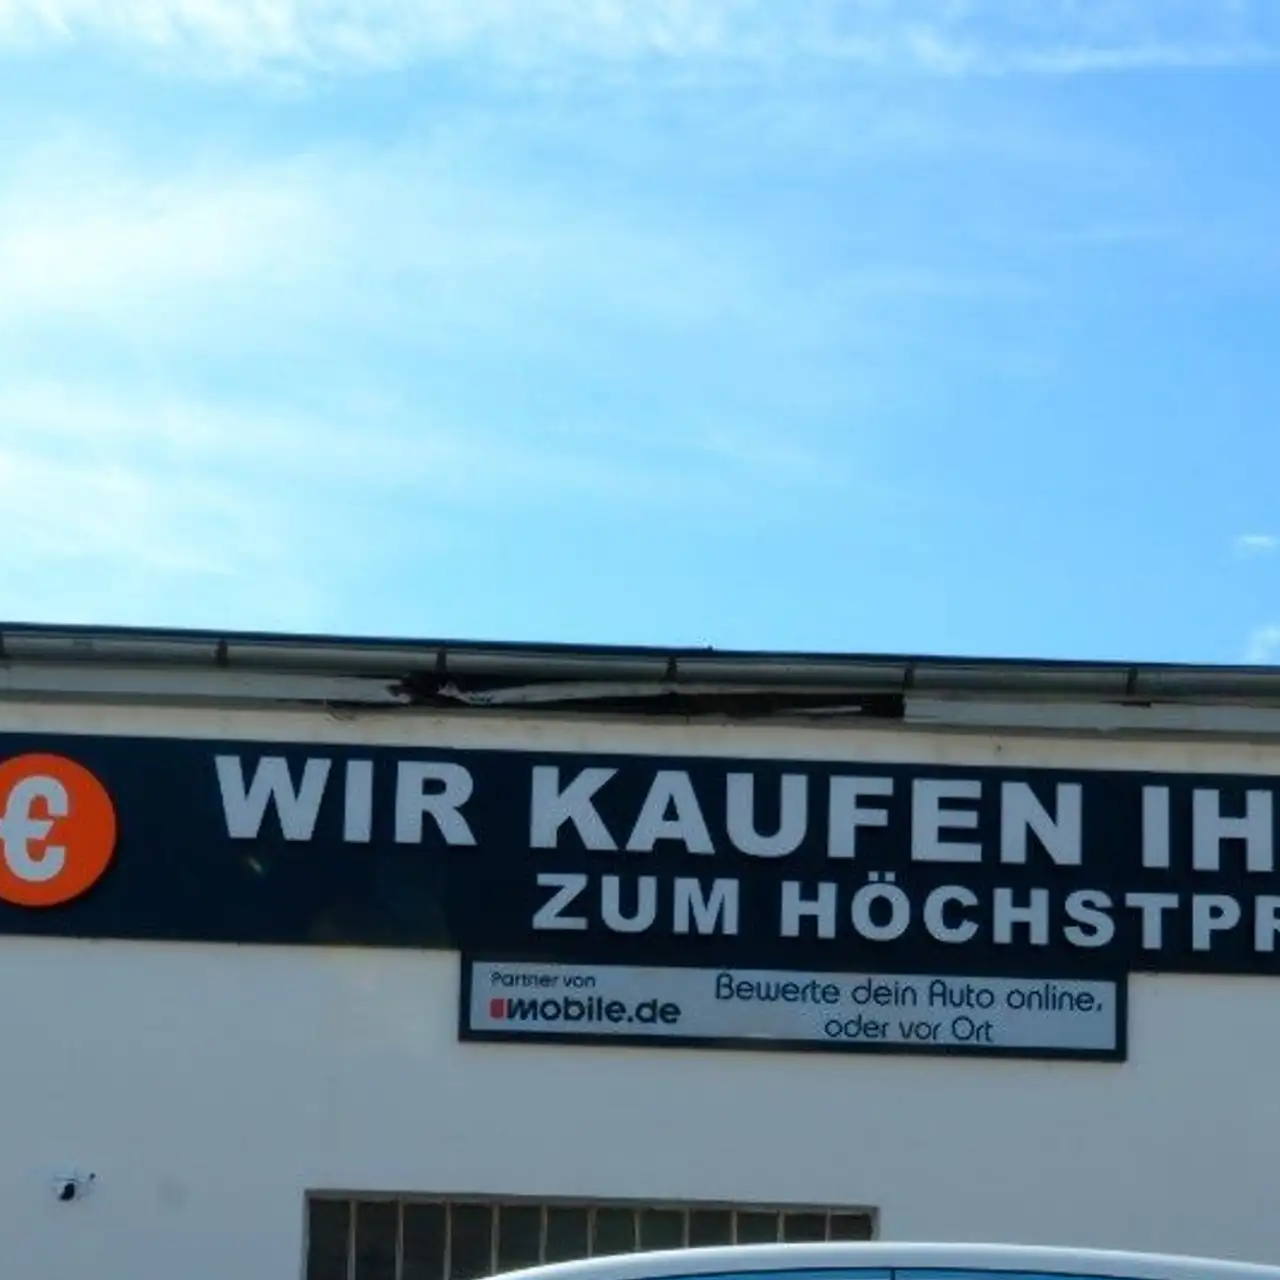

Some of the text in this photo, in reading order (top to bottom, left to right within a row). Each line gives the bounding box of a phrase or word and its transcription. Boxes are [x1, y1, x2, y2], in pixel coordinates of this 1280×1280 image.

[214, 755, 477, 846] WIR
[529, 765, 1083, 865] KAUFEN
[532, 873, 740, 935] ZUM
[484, 971, 596, 988] Partner von
[715, 972, 841, 1004] Bewerte
[851, 977, 918, 1007] dein
[928, 978, 995, 1009] Auto
[506, 996, 682, 1024] mobile.de
[824, 1013, 994, 1043] oder vor Ort
